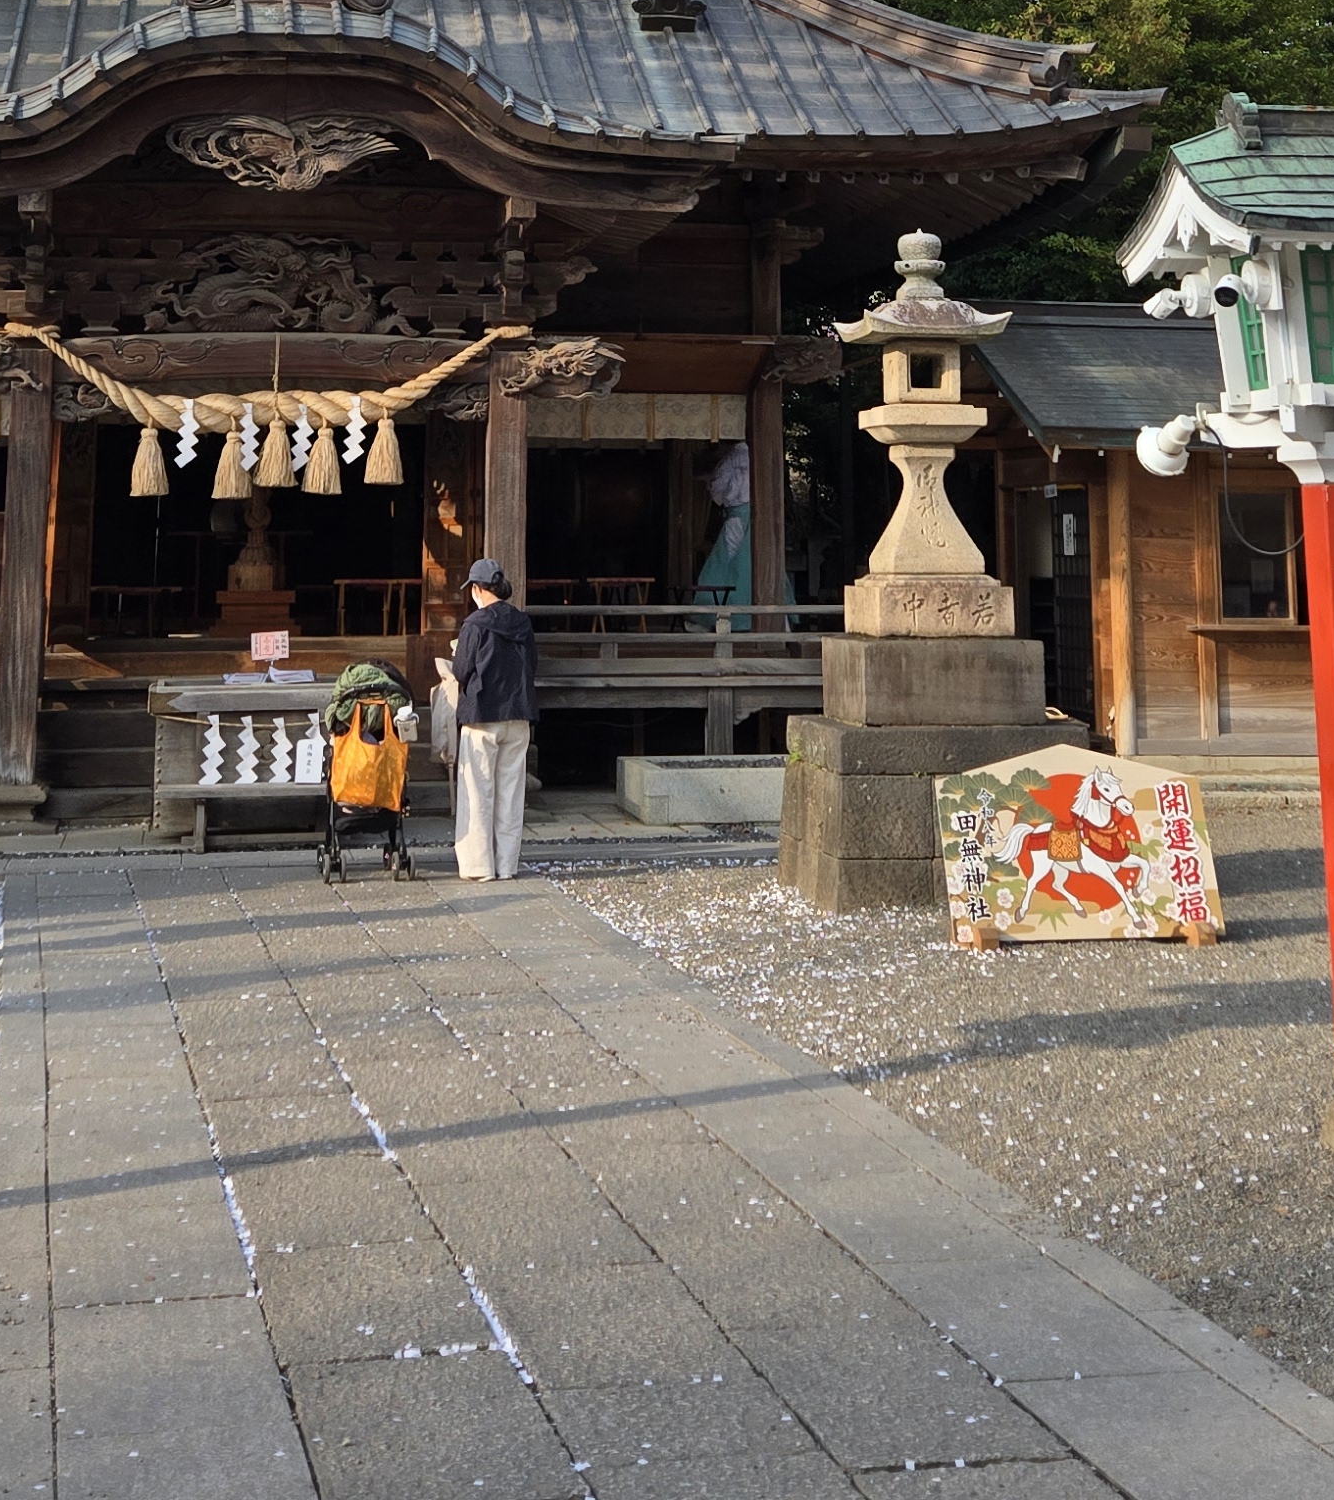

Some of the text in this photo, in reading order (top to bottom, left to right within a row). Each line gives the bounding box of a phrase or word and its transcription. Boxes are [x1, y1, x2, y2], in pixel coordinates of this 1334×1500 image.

[957, 813, 992, 923] 田無神社
[977, 788, 998, 849] 令和八年
[1157, 783, 1209, 923] 開運招福
